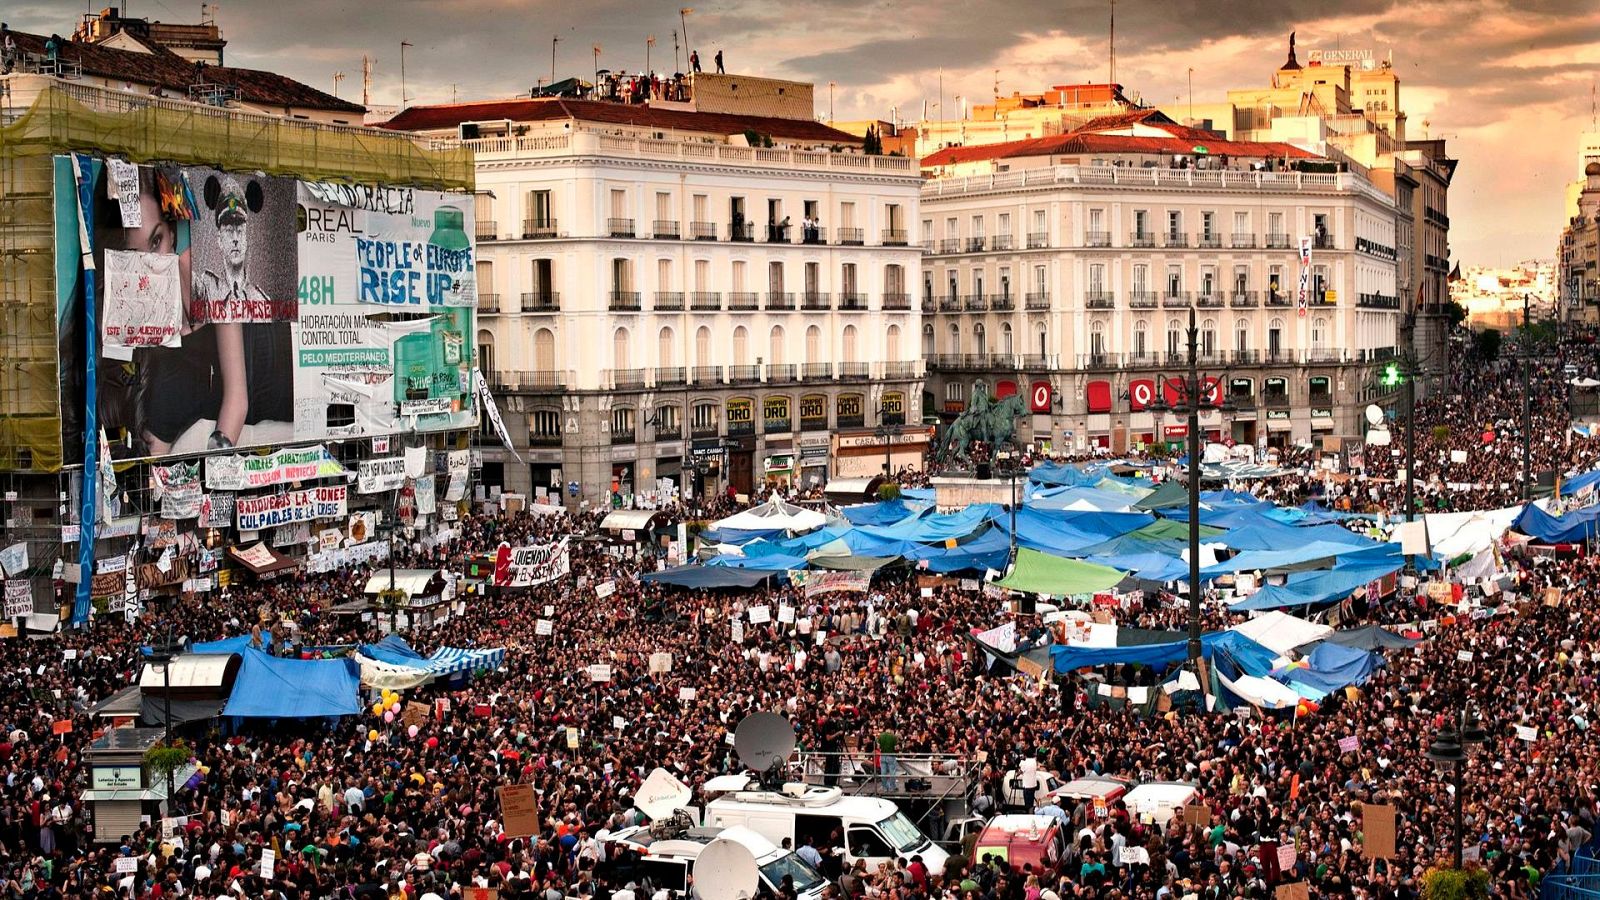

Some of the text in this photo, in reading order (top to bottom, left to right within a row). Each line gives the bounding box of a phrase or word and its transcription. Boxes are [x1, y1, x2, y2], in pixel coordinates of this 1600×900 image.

[1323, 49, 1373, 60] GENERALI
[411, 217, 431, 228] Nuevo
[356, 238, 474, 273] PEOPLE of EUROPE
[1298, 239, 1309, 316] FEMINISMO
[297, 275, 335, 305] 48H
[426, 273, 451, 305] UP
[301, 312, 351, 329] HIDRATACIÓN
[106, 326, 120, 336] ESTE
[127, 326, 135, 336] ES
[301, 331, 337, 345] CONTROL
[302, 351, 386, 363] PELO MEDITERRÁNEO
[800, 397, 823, 405] COMPRO
[836, 396, 860, 404] COMPRO
[727, 408, 750, 421] ORO
[764, 406, 787, 418] ORO
[800, 404, 823, 417] ORO
[836, 403, 860, 415] ORO
[854, 438, 875, 446] CASA
[285, 465, 317, 479] HIPOTECAS
[359, 463, 370, 478] STOP
[238, 492, 291, 514] BANQUEROS
[240, 503, 339, 529] CULPABLES DE LA CRISIS
